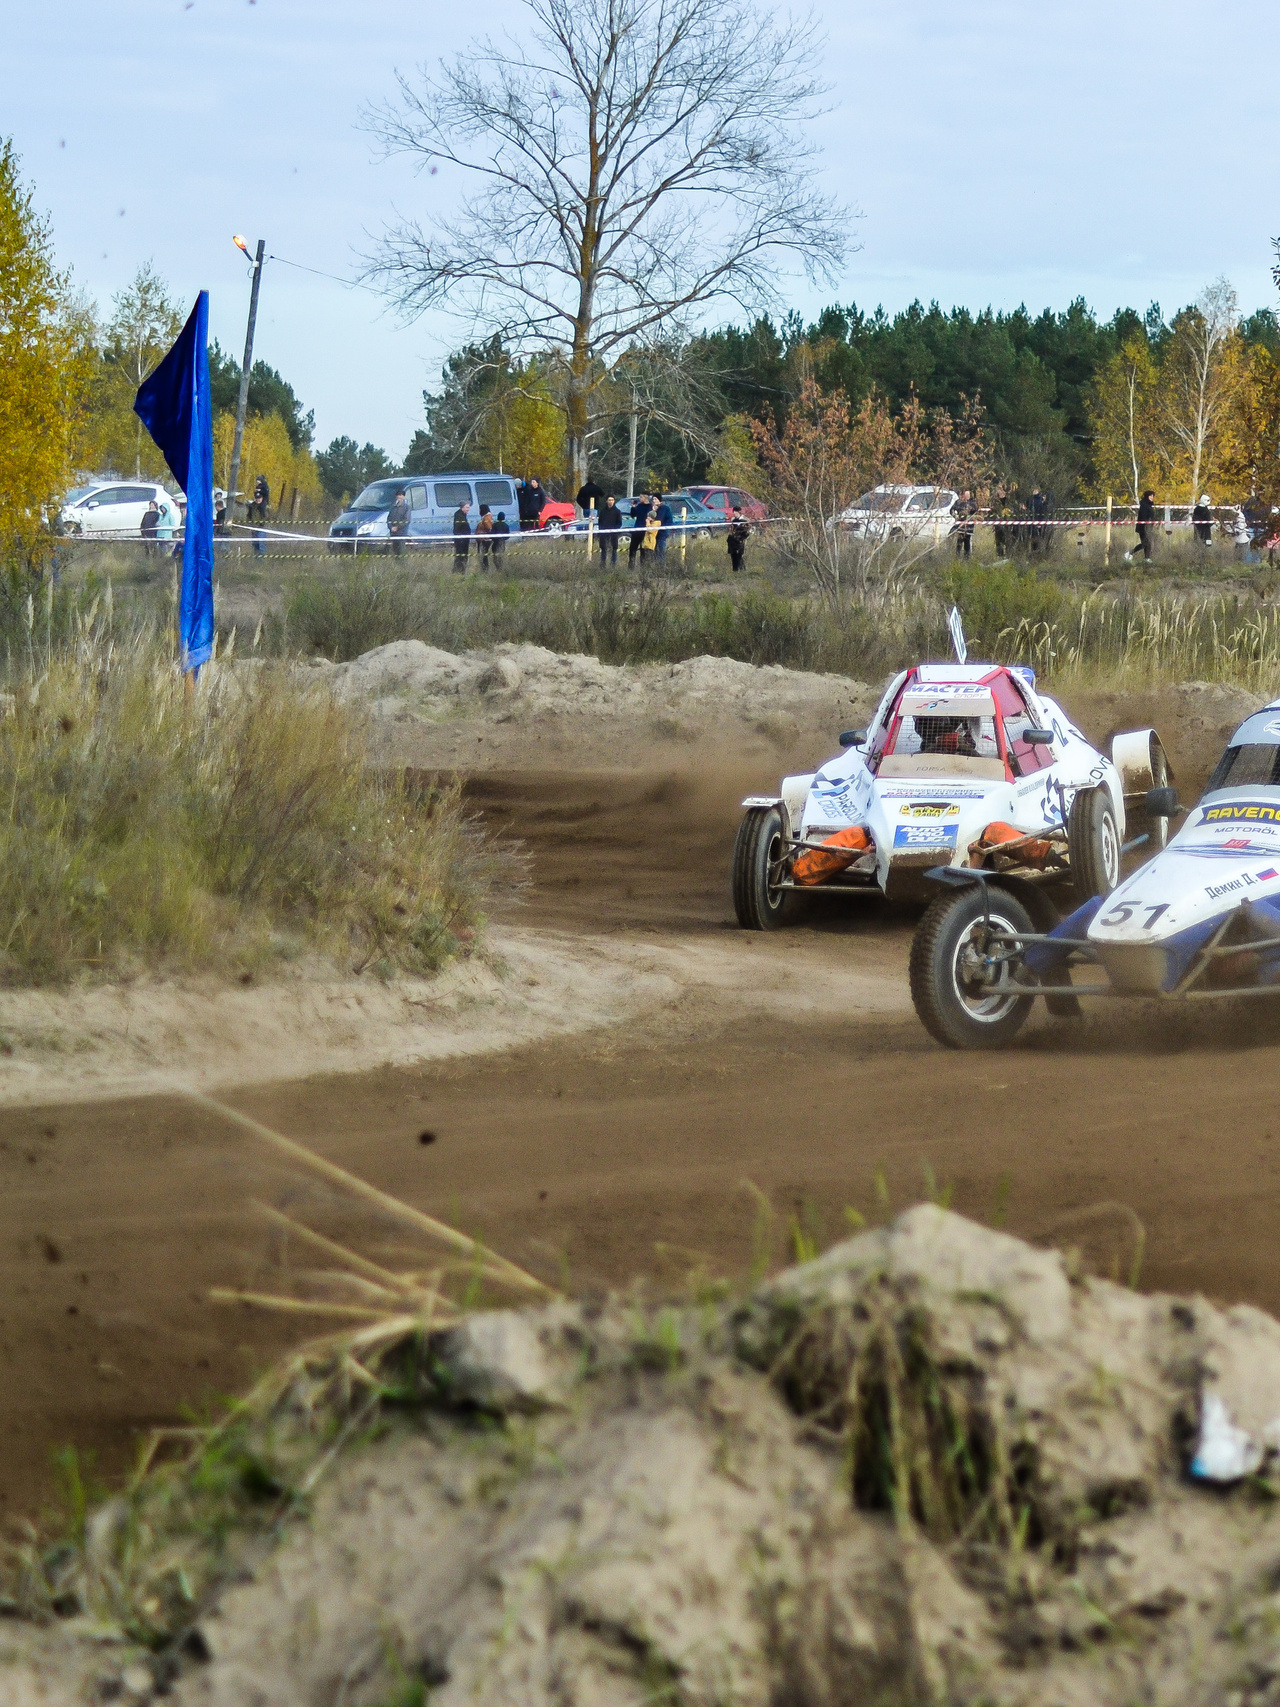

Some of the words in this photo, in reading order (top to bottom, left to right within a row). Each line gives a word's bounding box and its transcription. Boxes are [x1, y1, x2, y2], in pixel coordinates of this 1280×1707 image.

[1214, 826, 1278, 836] MOTORÖL
[1204, 878, 1243, 899] Демин
[1241, 872, 1258, 885] Д.
[1100, 900, 1171, 929] 51
